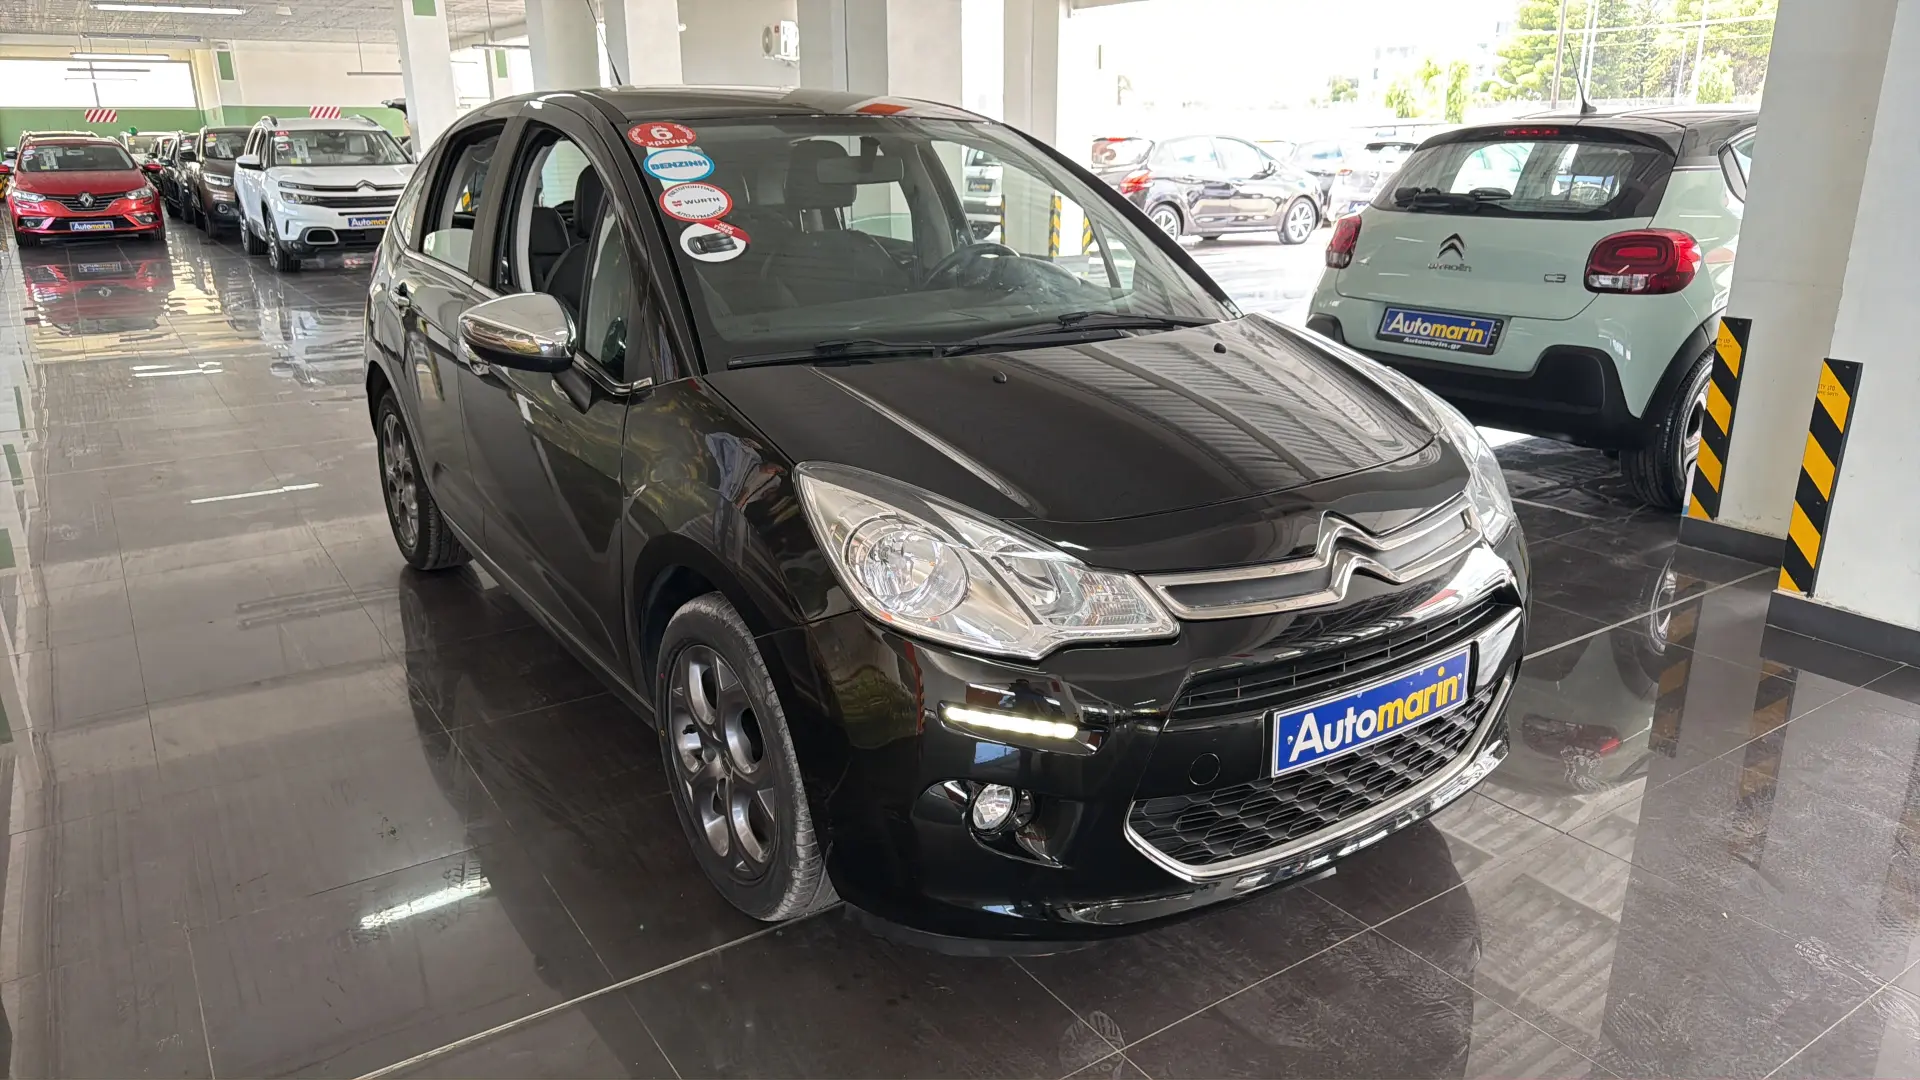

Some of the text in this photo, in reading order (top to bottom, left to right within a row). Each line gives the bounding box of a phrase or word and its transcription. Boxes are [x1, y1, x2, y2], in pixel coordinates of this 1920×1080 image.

[650, 127, 673, 140] 6
[646, 138, 688, 147] χρόνια
[73, 222, 111, 230] Automarin
[1543, 273, 1567, 283] C3
[1387, 312, 1485, 343] Automarin
[1403, 337, 1462, 350] Automarin.gr
[1288, 666, 1459, 763] Automarin
